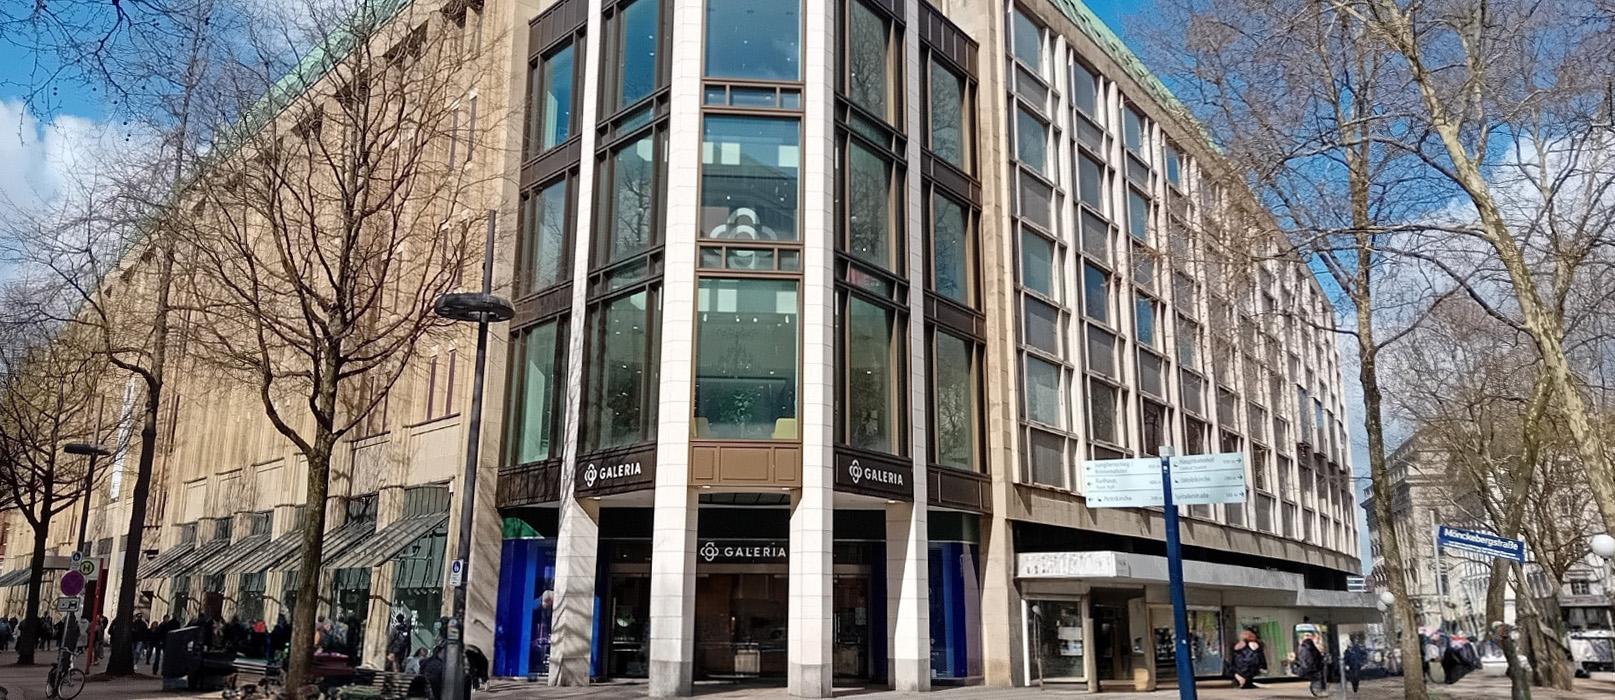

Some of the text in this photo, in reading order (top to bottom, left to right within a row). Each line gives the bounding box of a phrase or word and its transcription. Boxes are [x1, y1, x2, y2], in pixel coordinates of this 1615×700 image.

[599, 462, 642, 480] GALERIA
[864, 468, 904, 486] GALERIA
[1444, 528, 1519, 551] Mönckebergstraße
[724, 547, 786, 558] GALERIA
[83, 564, 91, 572] H
